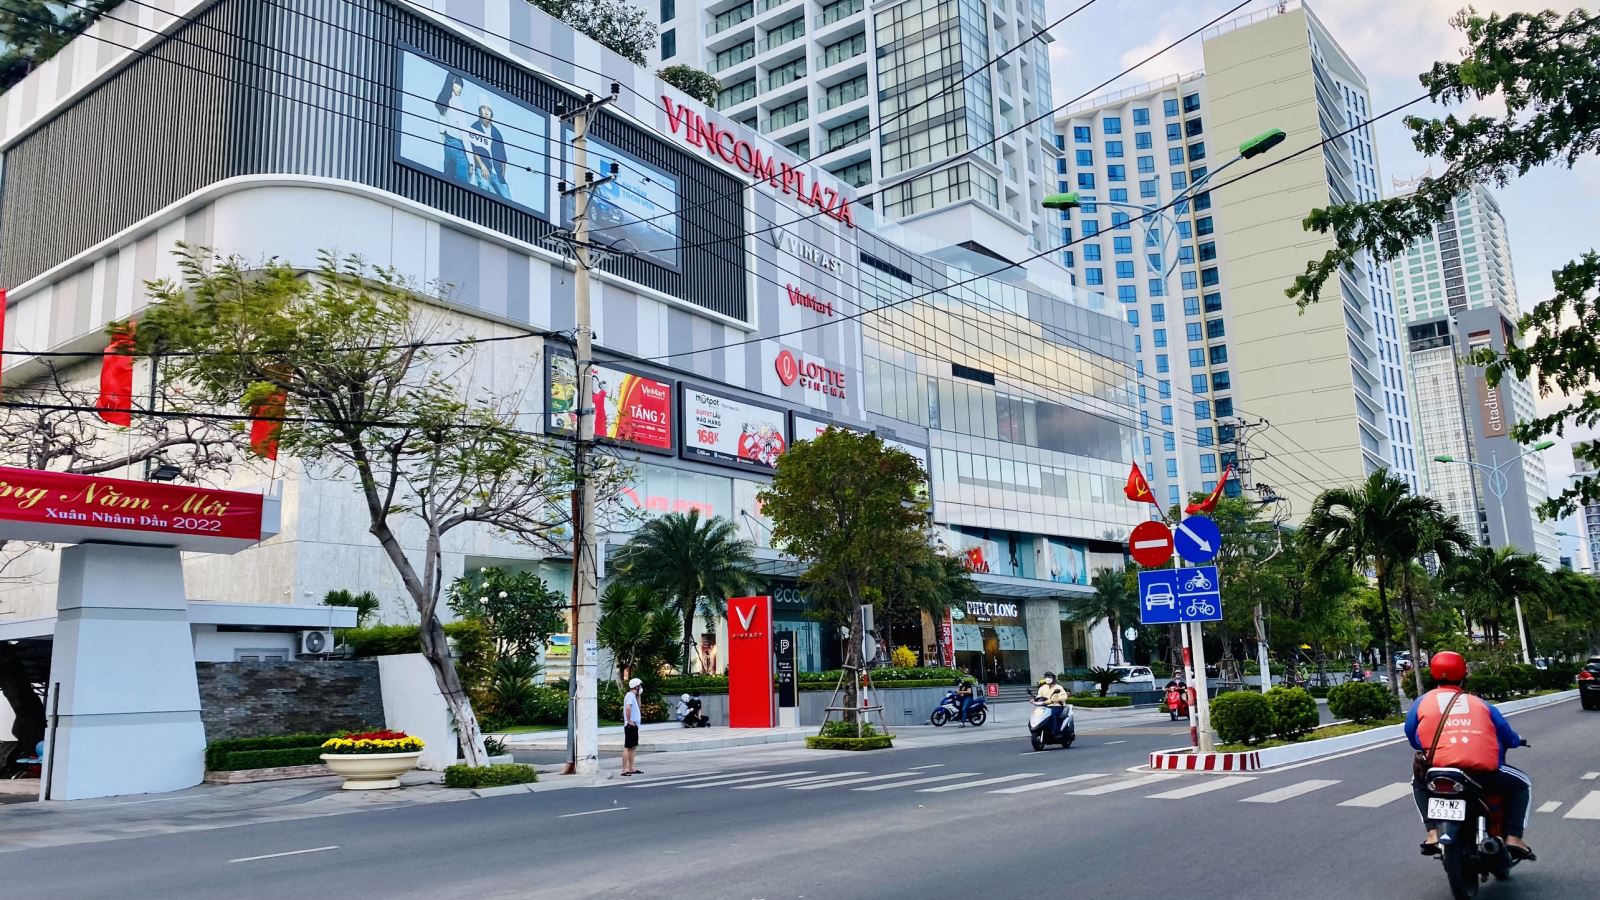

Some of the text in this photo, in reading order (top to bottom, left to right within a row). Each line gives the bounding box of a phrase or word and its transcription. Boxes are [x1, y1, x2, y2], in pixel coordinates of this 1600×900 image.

[661, 95, 855, 228] VINCOM PLAZA
[788, 237, 844, 275] VINFAST
[786, 283, 833, 317] VinMart
[799, 359, 846, 388] LOTTE
[641, 384, 666, 398] VinMart
[800, 377, 846, 399] CINEMA
[660, 412, 666, 424] 2
[60, 482, 151, 509] Năm
[162, 493, 230, 517] Mới
[45, 507, 87, 521] Xuân
[92, 511, 135, 525] Nhâm
[172, 516, 222, 532] 2022
[993, 602, 1018, 618] LONG
